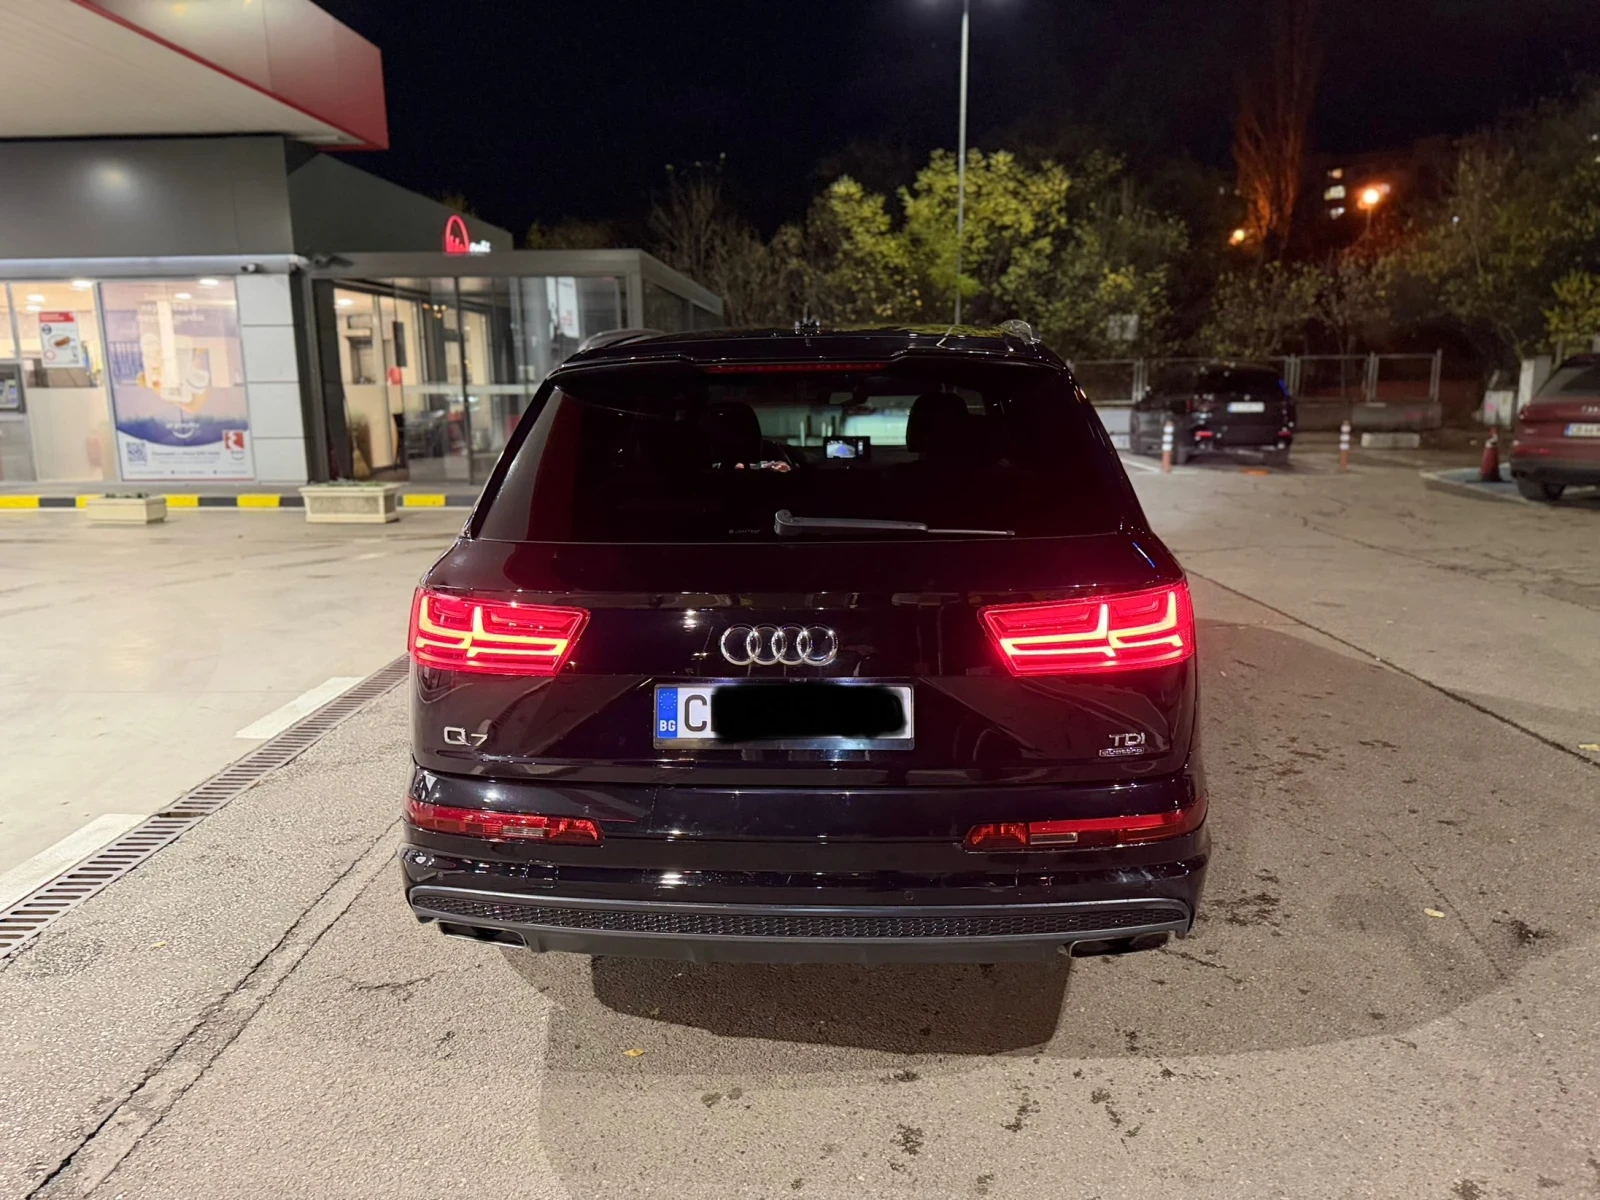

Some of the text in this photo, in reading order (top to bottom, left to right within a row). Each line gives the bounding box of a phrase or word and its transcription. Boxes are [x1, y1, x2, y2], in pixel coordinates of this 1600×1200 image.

[660, 720, 676, 732] BG
[443, 726, 488, 747] Q7
[1108, 732, 1146, 747] TDI
